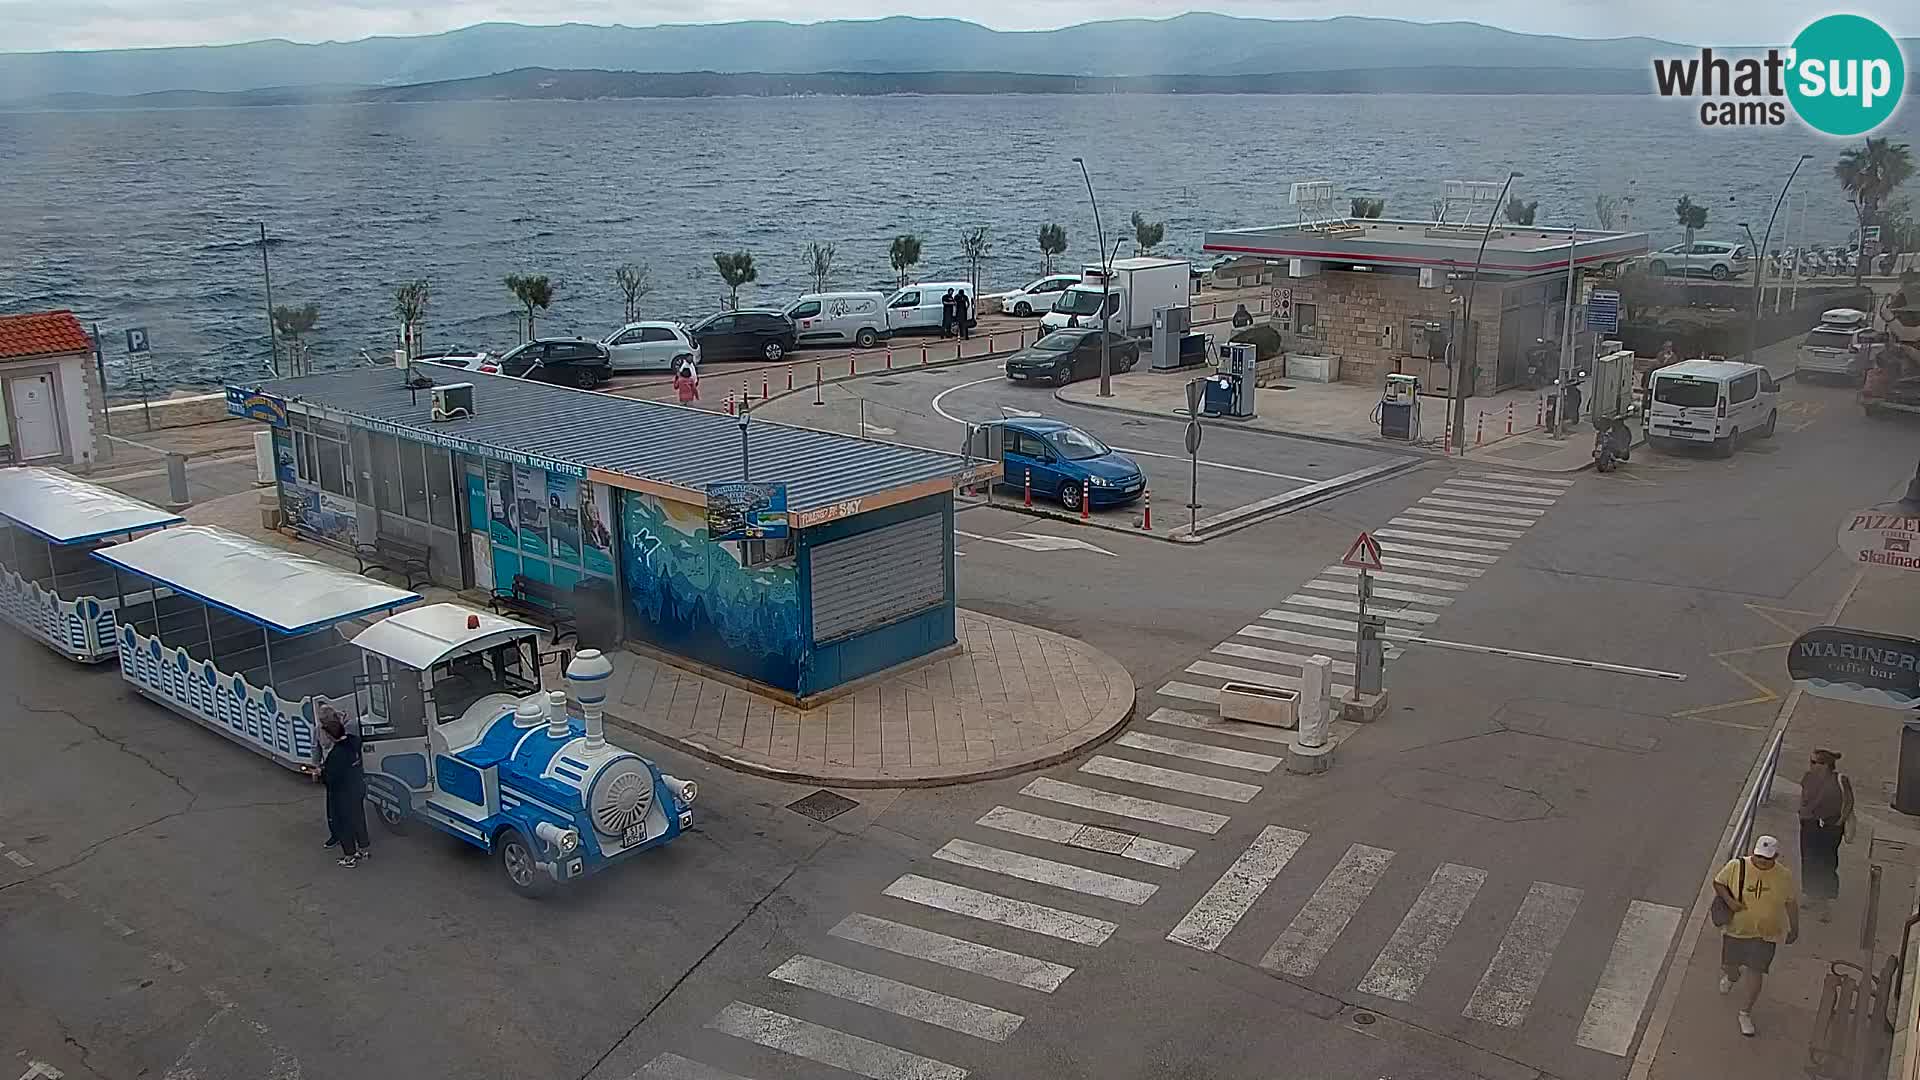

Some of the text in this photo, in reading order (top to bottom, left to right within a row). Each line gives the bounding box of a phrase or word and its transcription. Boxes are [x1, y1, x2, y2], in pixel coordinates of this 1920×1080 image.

[132, 331, 144, 349] P
[437, 437, 469, 451] POSTAJA
[479, 445, 494, 457] BUS
[495, 450, 527, 465] STATION
[528, 456, 555, 471] TICKET
[556, 462, 583, 477] OFFICE
[839, 499, 862, 516] SKY
[1847, 515, 1920, 533] PIZZE
[1800, 642, 1920, 673] MARINER
[1870, 664, 1897, 679] bar
